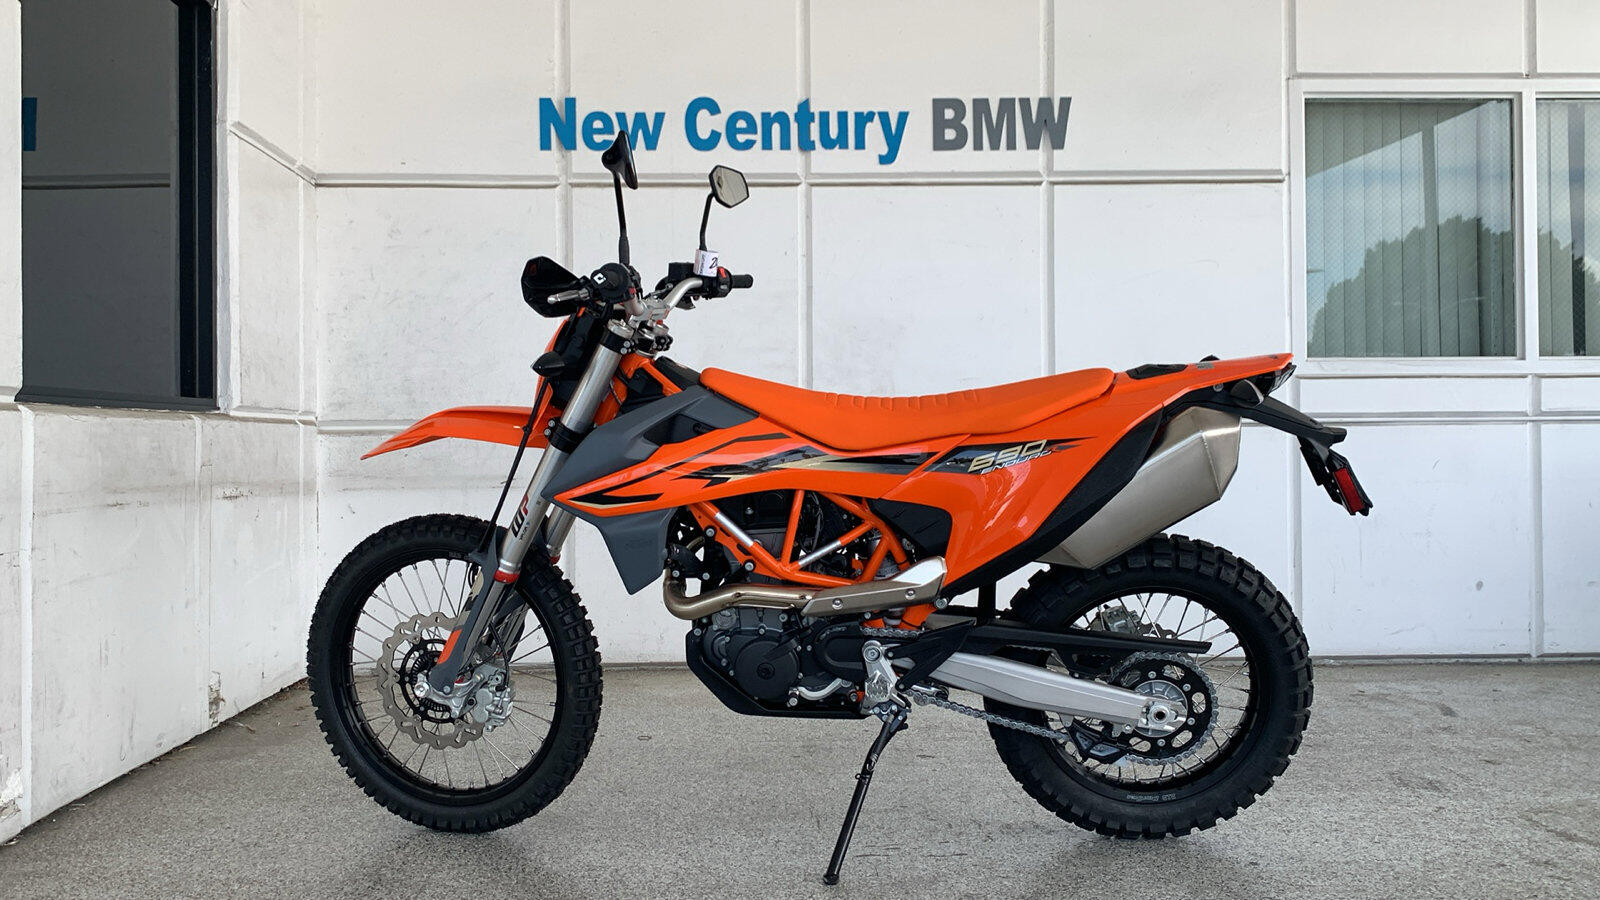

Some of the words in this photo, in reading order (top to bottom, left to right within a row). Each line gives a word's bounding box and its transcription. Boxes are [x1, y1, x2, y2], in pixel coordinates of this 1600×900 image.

[538, 97, 665, 151] New
[684, 96, 908, 164] Century
[932, 97, 1071, 151] BMW
[967, 439, 1047, 473] 690
[981, 450, 1052, 475] ENDURO
